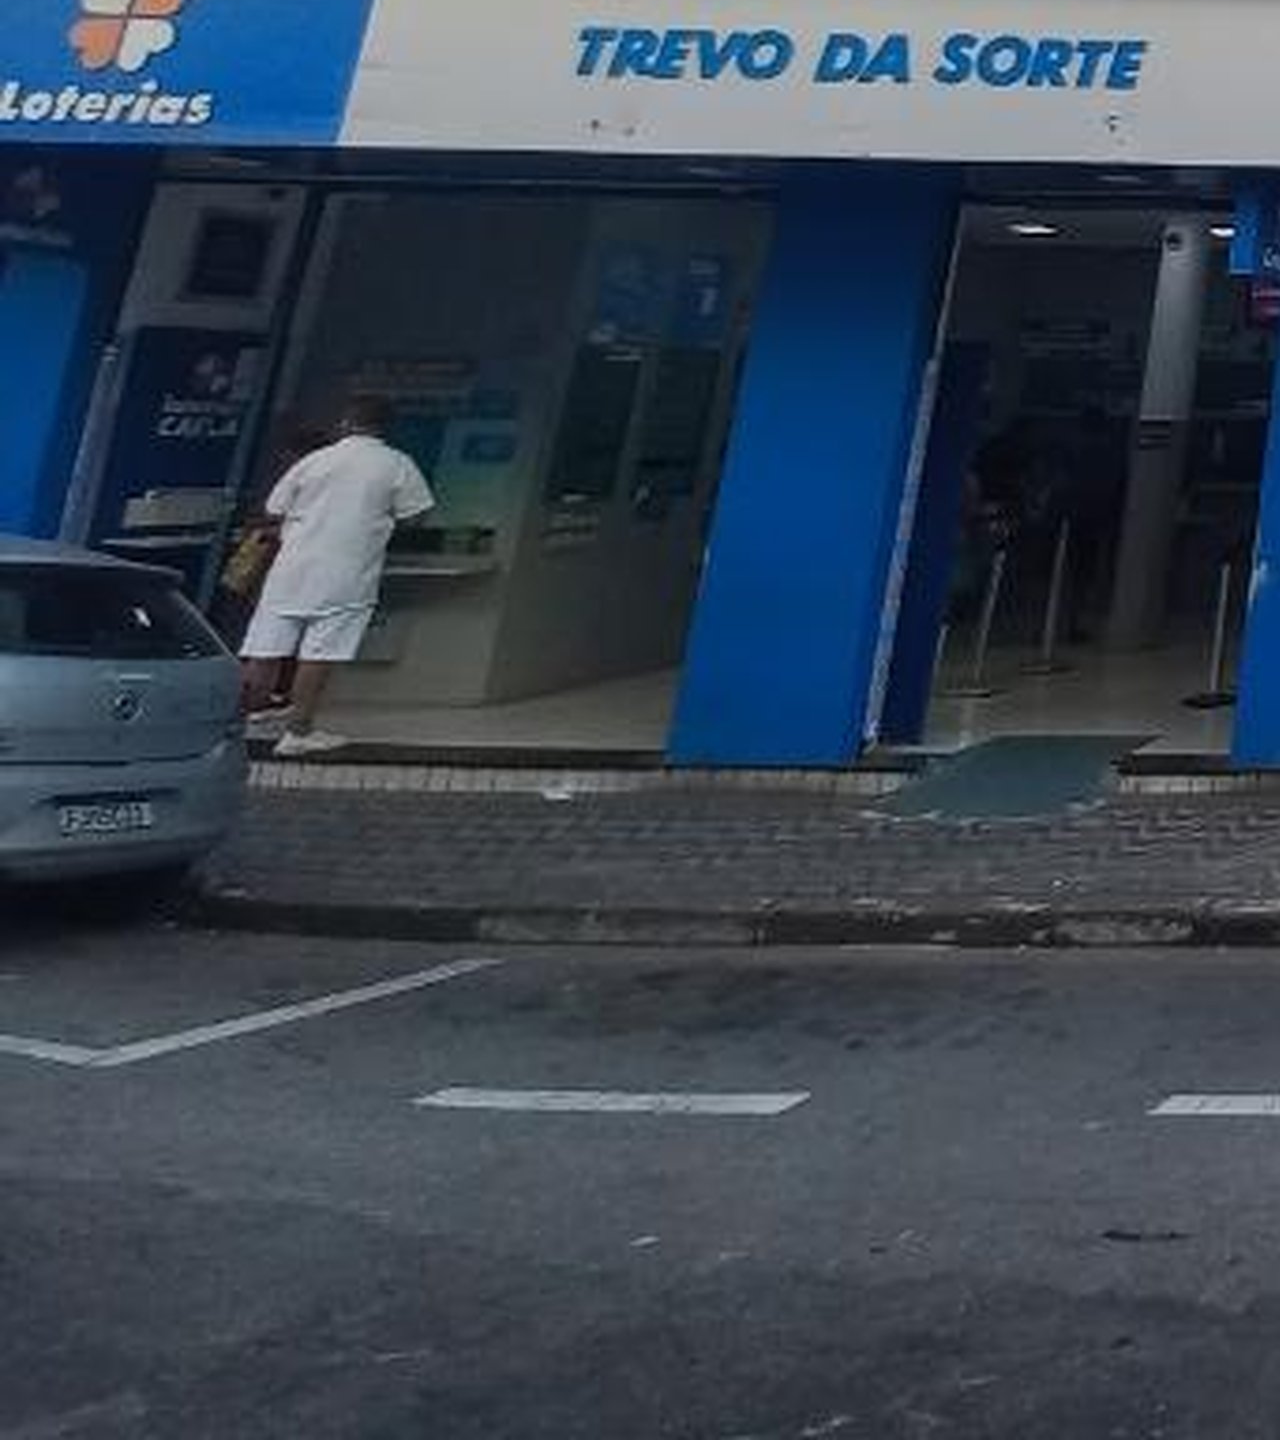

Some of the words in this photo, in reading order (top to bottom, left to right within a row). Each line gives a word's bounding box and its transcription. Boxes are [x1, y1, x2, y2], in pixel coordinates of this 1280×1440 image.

[577, 27, 794, 81] TREVO
[813, 32, 911, 84] DA
[933, 33, 1147, 91] SORTE
[0, 81, 213, 125] Loterias
